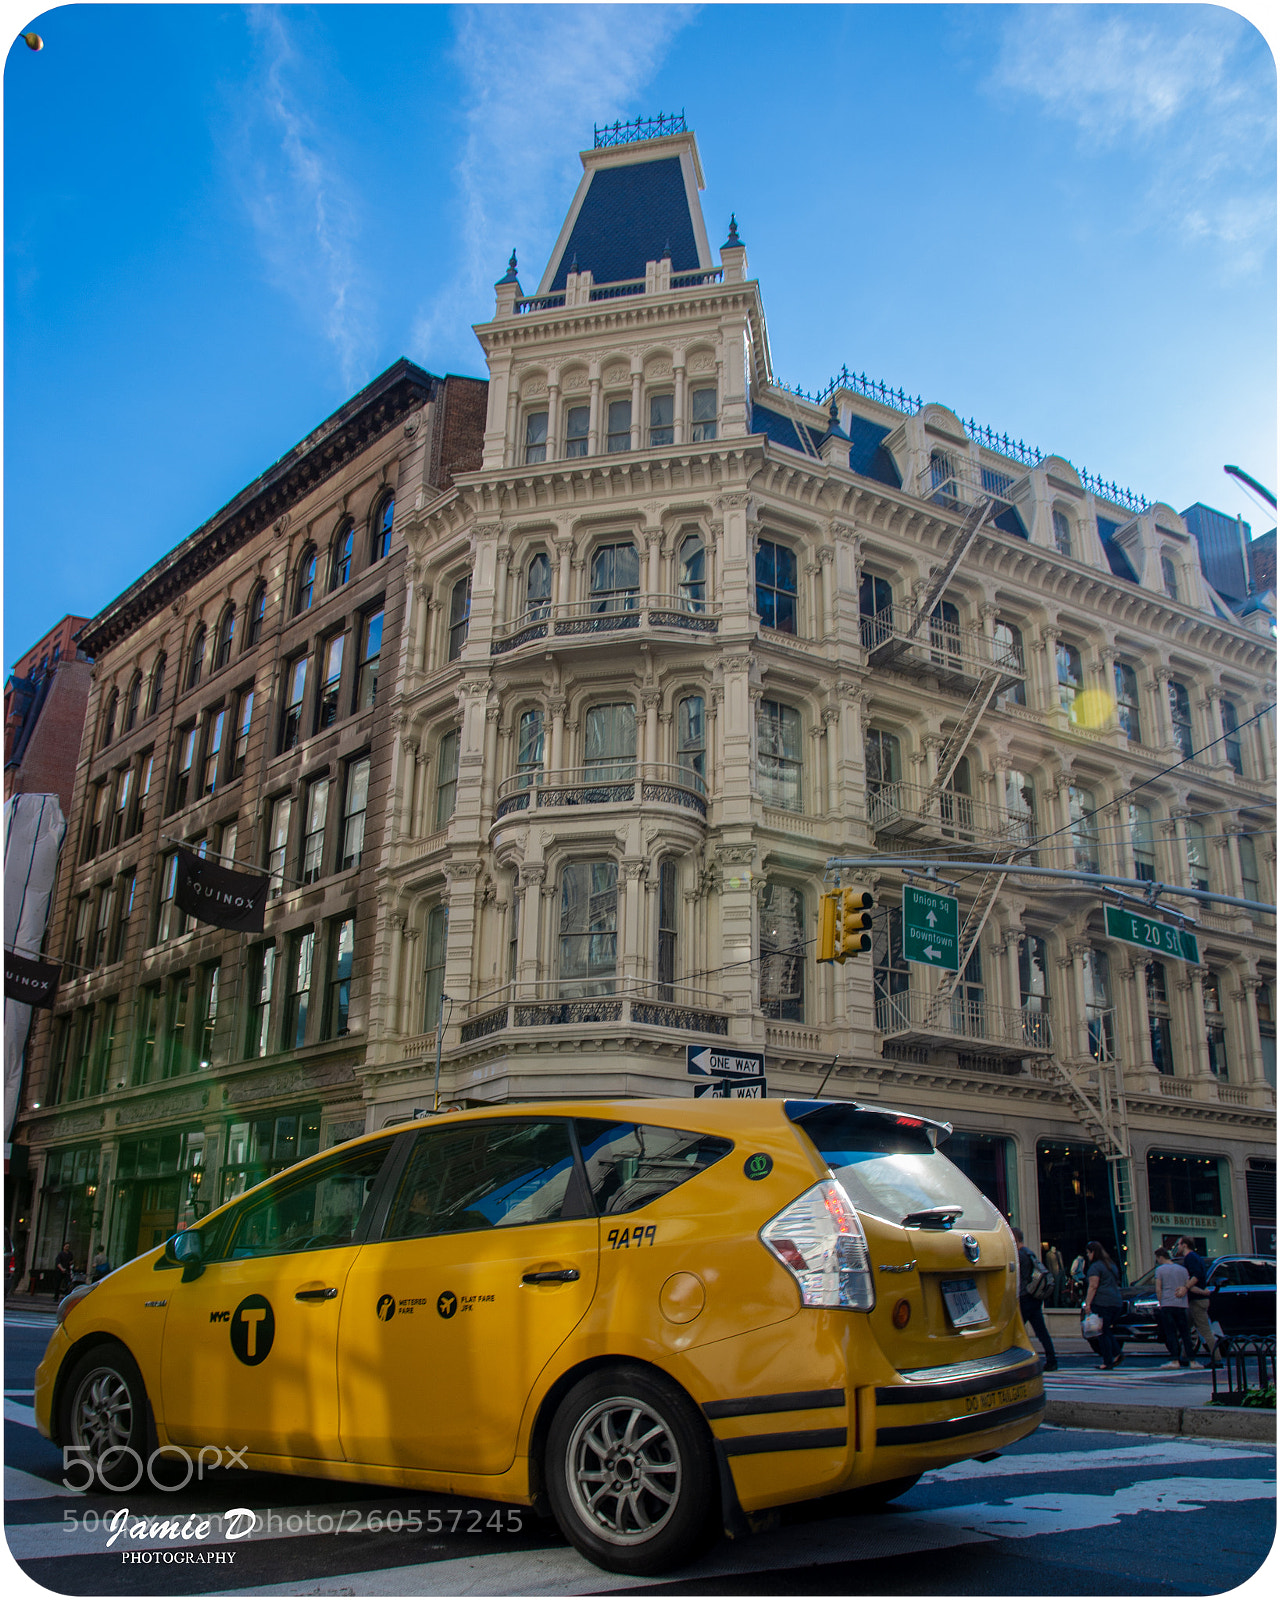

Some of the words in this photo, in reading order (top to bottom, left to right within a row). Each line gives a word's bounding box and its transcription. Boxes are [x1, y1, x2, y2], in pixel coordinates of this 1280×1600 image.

[913, 893, 937, 908] Union
[940, 900, 949, 914] Sq
[910, 927, 953, 947] Downtown
[1131, 919, 1139, 939] E
[1144, 923, 1160, 945] 20
[1165, 931, 1178, 952] St
[709, 1055, 730, 1069] ONE
[735, 1059, 757, 1072] WAY
[1173, 1216, 1217, 1227] BROTHERS
[607, 1225, 657, 1249] 9A99
[398, 1298, 427, 1306] METERED
[461, 1296, 477, 1304] FLAT
[210, 1311, 231, 1323] NYC
[241, 1308, 266, 1357] T
[966, 1396, 979, 1411] DO
